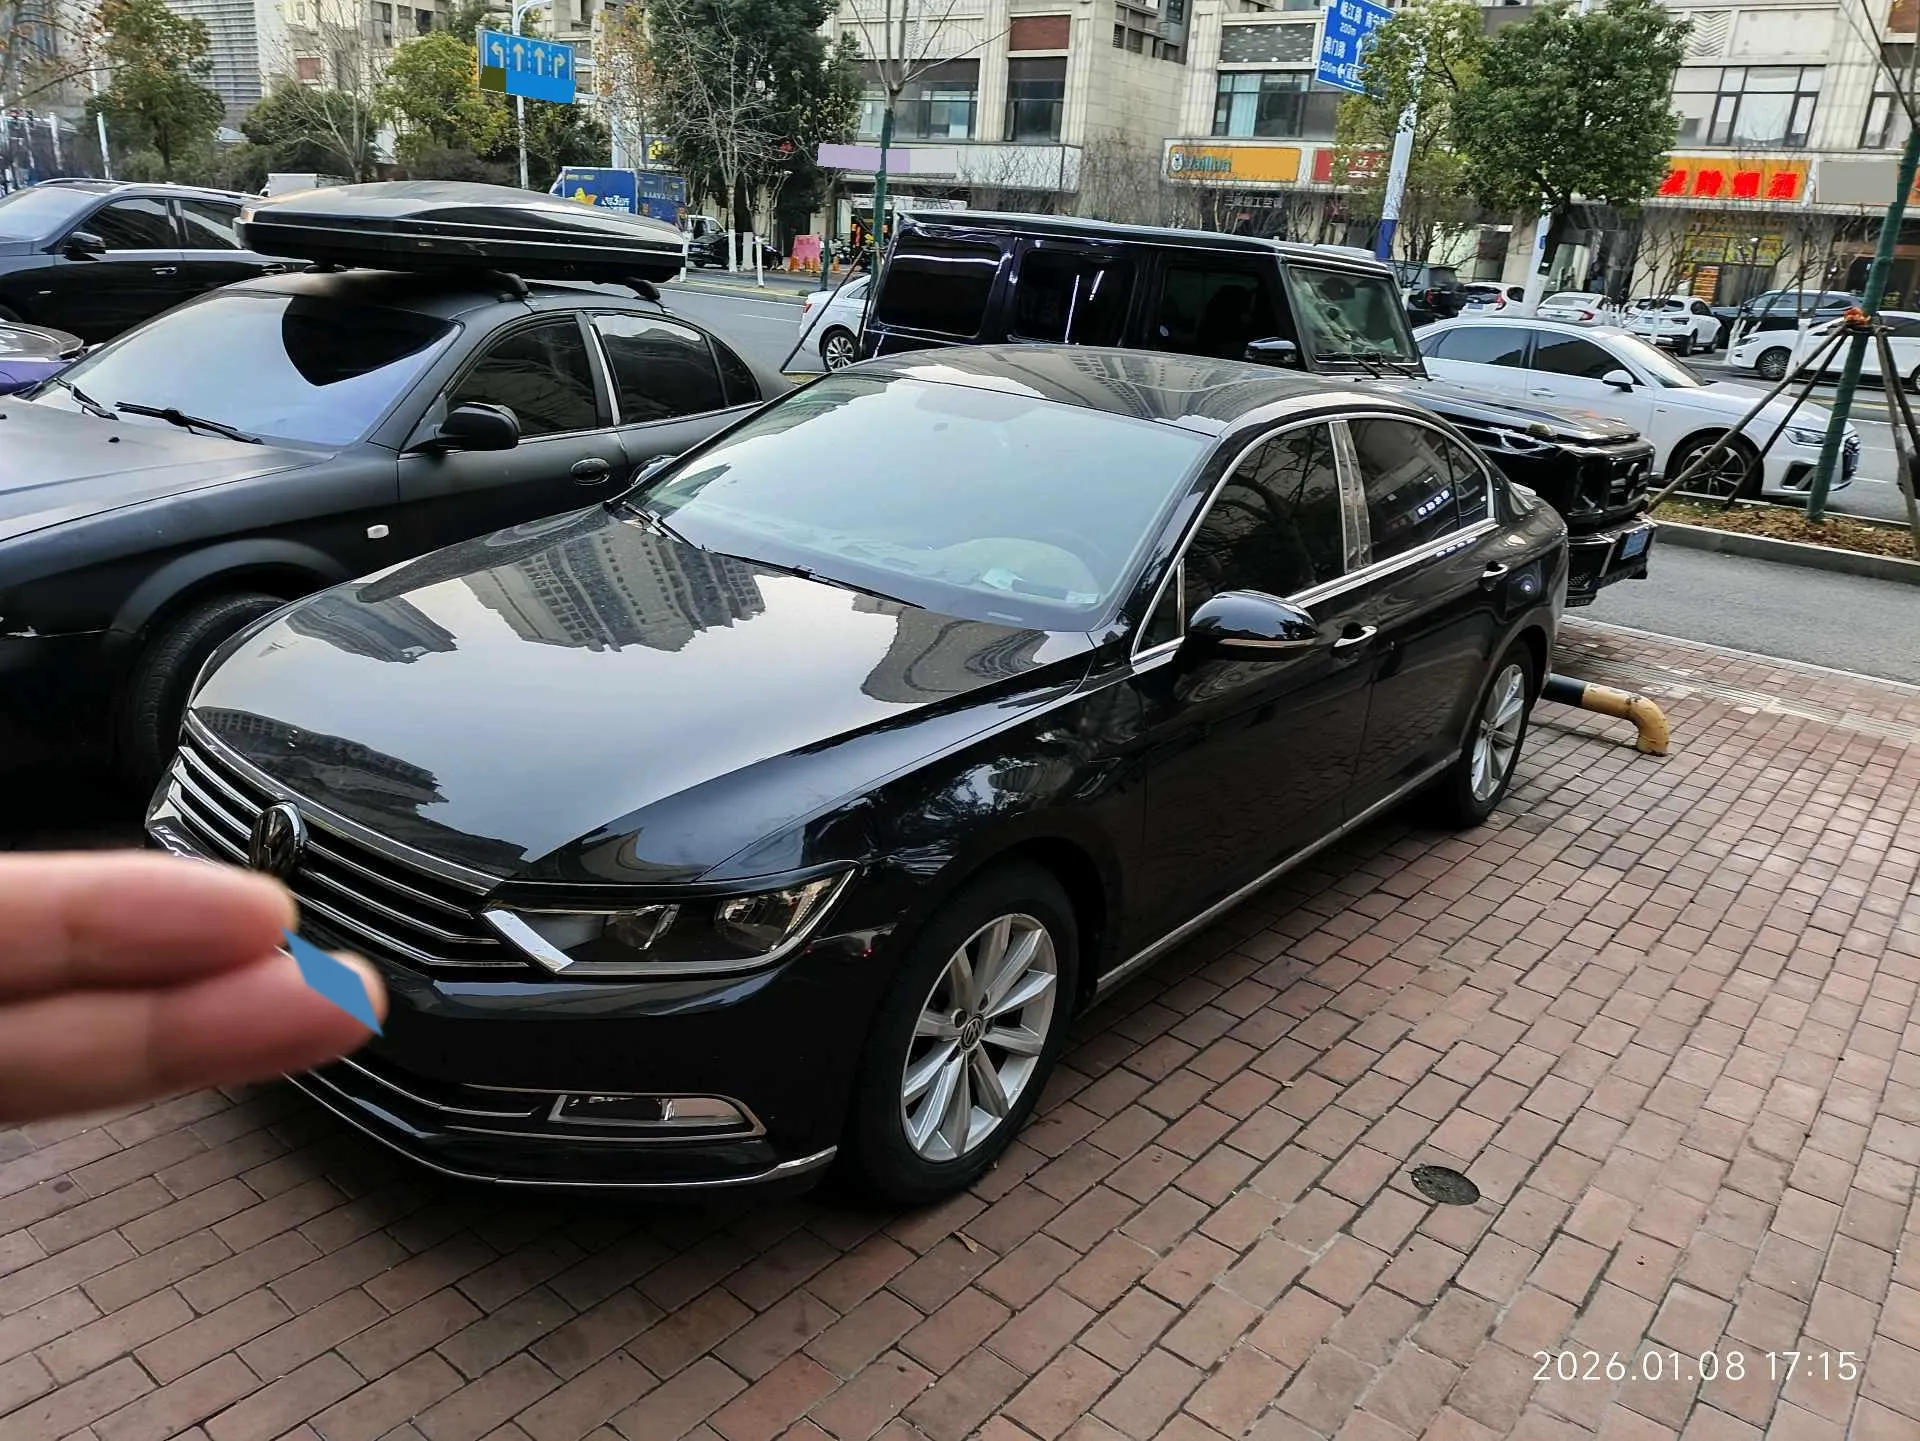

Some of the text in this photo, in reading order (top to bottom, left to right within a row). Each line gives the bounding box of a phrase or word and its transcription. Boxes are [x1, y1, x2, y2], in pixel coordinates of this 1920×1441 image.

[1339, 22, 1357, 36] 200m
[1323, 36, 1346, 59] 澳门路
[1320, 60, 1337, 74] 200m
